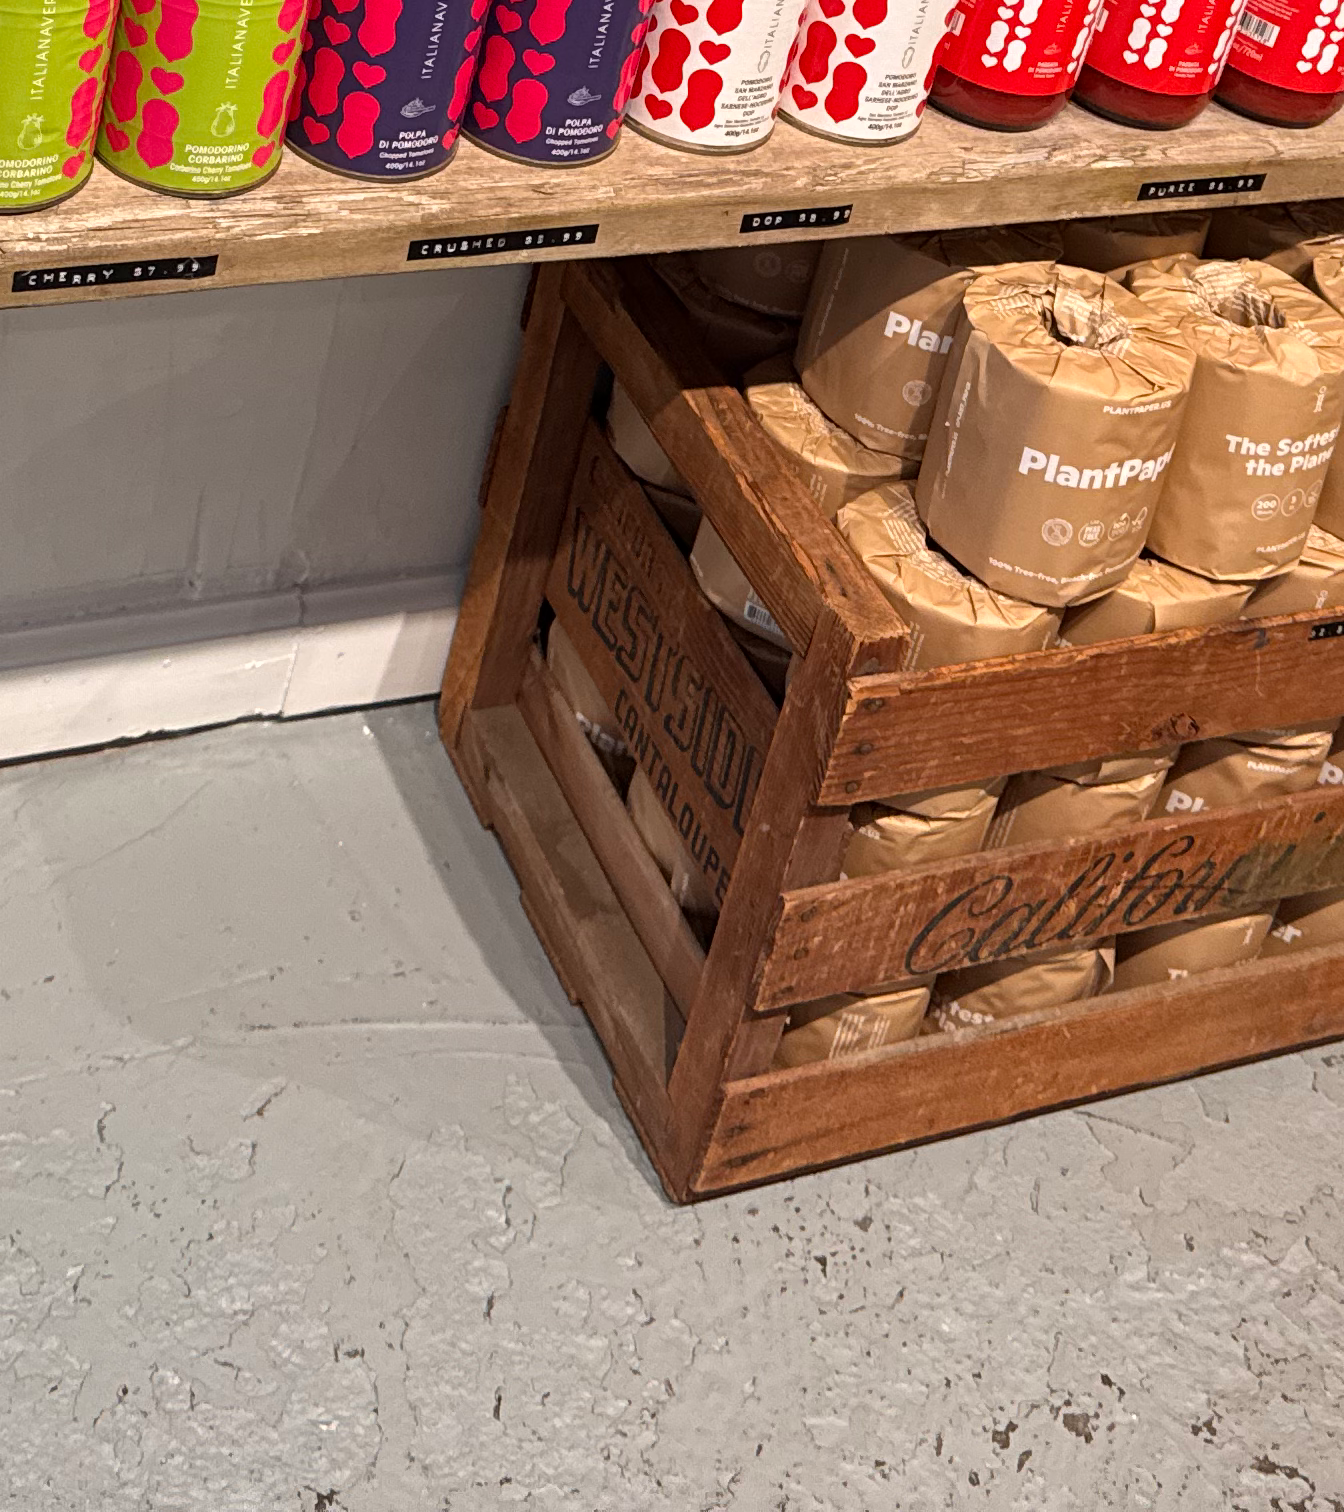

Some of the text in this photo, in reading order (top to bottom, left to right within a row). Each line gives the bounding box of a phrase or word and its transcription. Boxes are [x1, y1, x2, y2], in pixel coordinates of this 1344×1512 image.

[565, 119, 591, 127] POLPA
[399, 130, 426, 139] POLPA
[546, 125, 603, 136] DI POMODORO
[184, 143, 250, 155] POMODORINO
[379, 136, 438, 149] DI POMODORO
[187, 154, 243, 164] CORBARINO
[1148, 183, 1195, 196] PUREE
[752, 216, 782, 227] DOP
[421, 238, 506, 254] CRUSHED
[28, 263, 199, 285] CHERRY $7.99
[1103, 400, 1172, 415] PLANTPAPER.US
[1226, 434, 1271, 456] The
[1246, 459, 1284, 476] the
[1257, 500, 1276, 509] 200
[616, 688, 730, 912] CANTALOUPE
